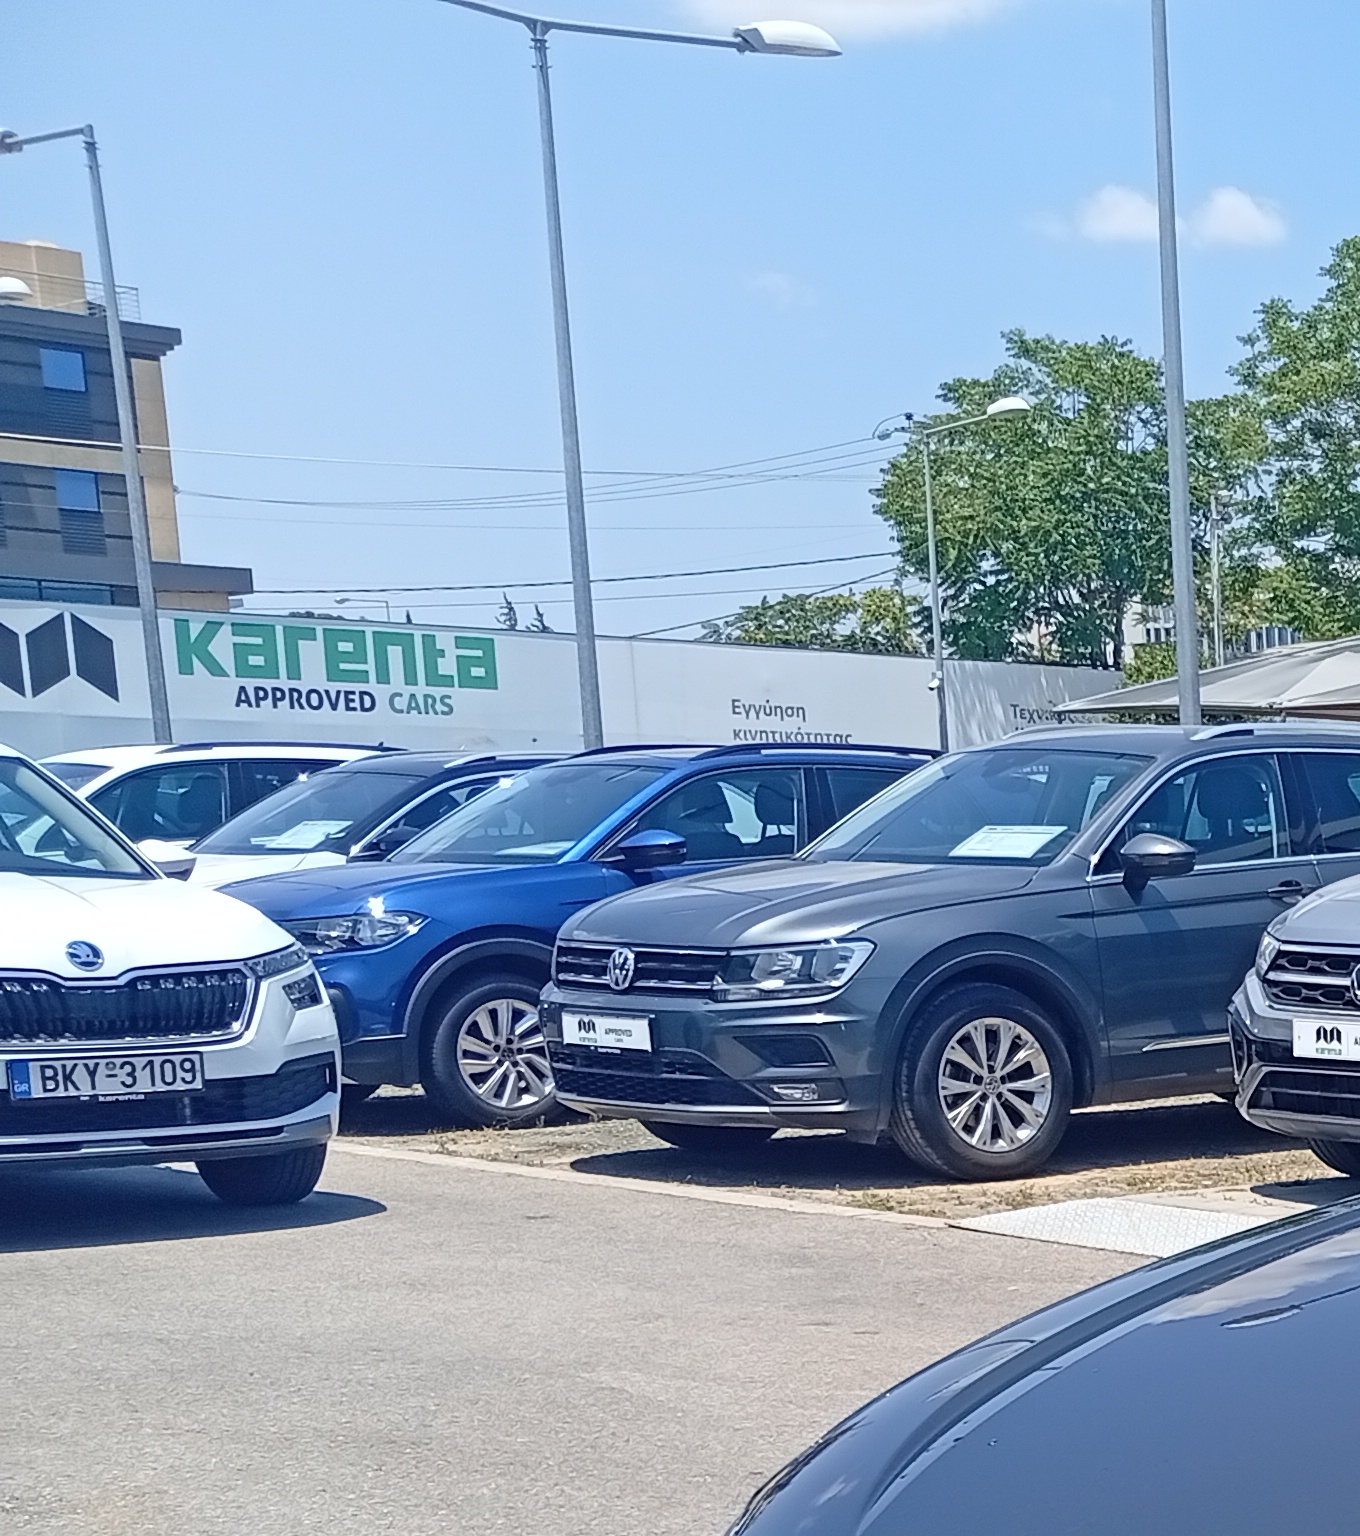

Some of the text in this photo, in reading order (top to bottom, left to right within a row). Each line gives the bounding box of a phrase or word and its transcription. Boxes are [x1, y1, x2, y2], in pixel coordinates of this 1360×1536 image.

[235, 685, 455, 716] APPROVED CARS
[731, 698, 806, 722] Εγγύηση
